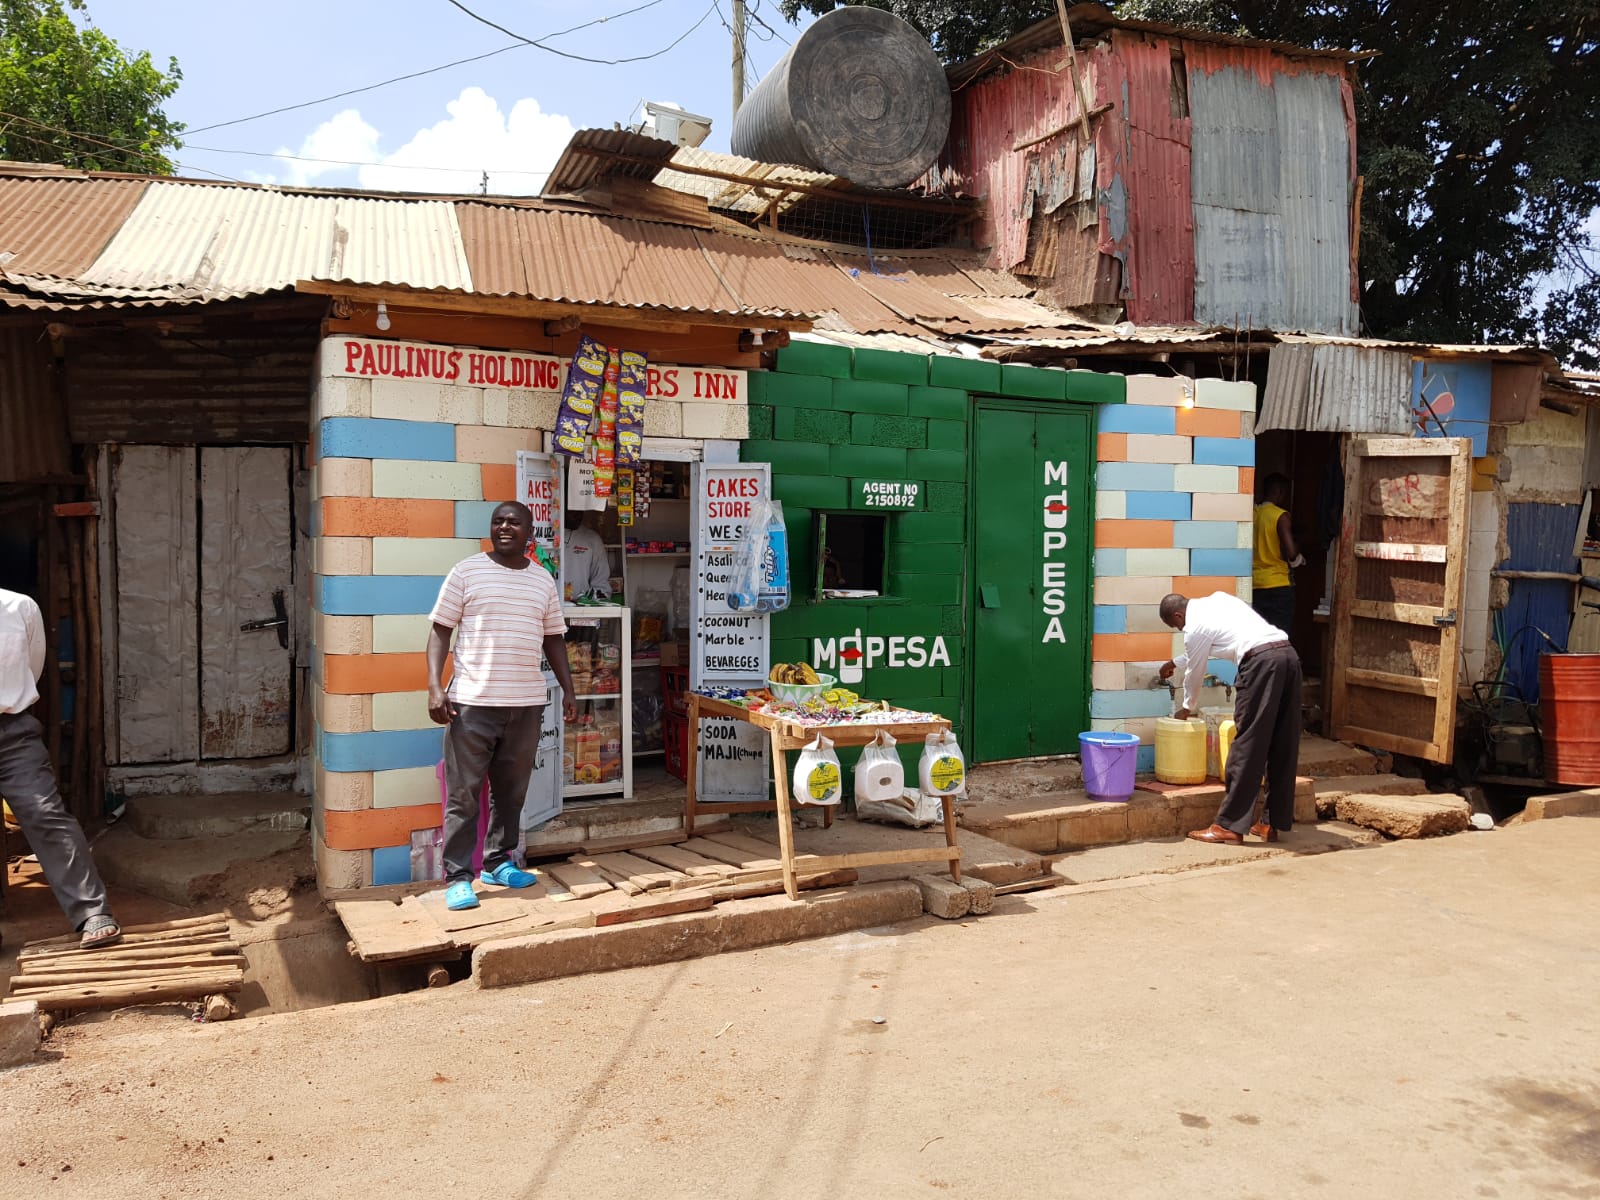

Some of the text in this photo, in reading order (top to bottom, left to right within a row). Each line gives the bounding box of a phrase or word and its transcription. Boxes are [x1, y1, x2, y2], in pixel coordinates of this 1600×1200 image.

[344, 342, 463, 379] PAULINUS
[468, 353, 559, 389] HOLDING
[694, 371, 738, 399] INN
[528, 479, 553, 499] AKES
[707, 478, 759, 497] CAKES
[862, 482, 918, 496] AGENT NO
[865, 494, 916, 507] 2150892
[527, 503, 551, 522] TORE
[708, 525, 730, 539] WE
[707, 553, 733, 567] Asali
[706, 589, 725, 601] Hea
[704, 617, 750, 628] COCONUT
[705, 633, 745, 646] Marble
[705, 655, 760, 668] BEVAREGES
[705, 725, 737, 740] SODA
